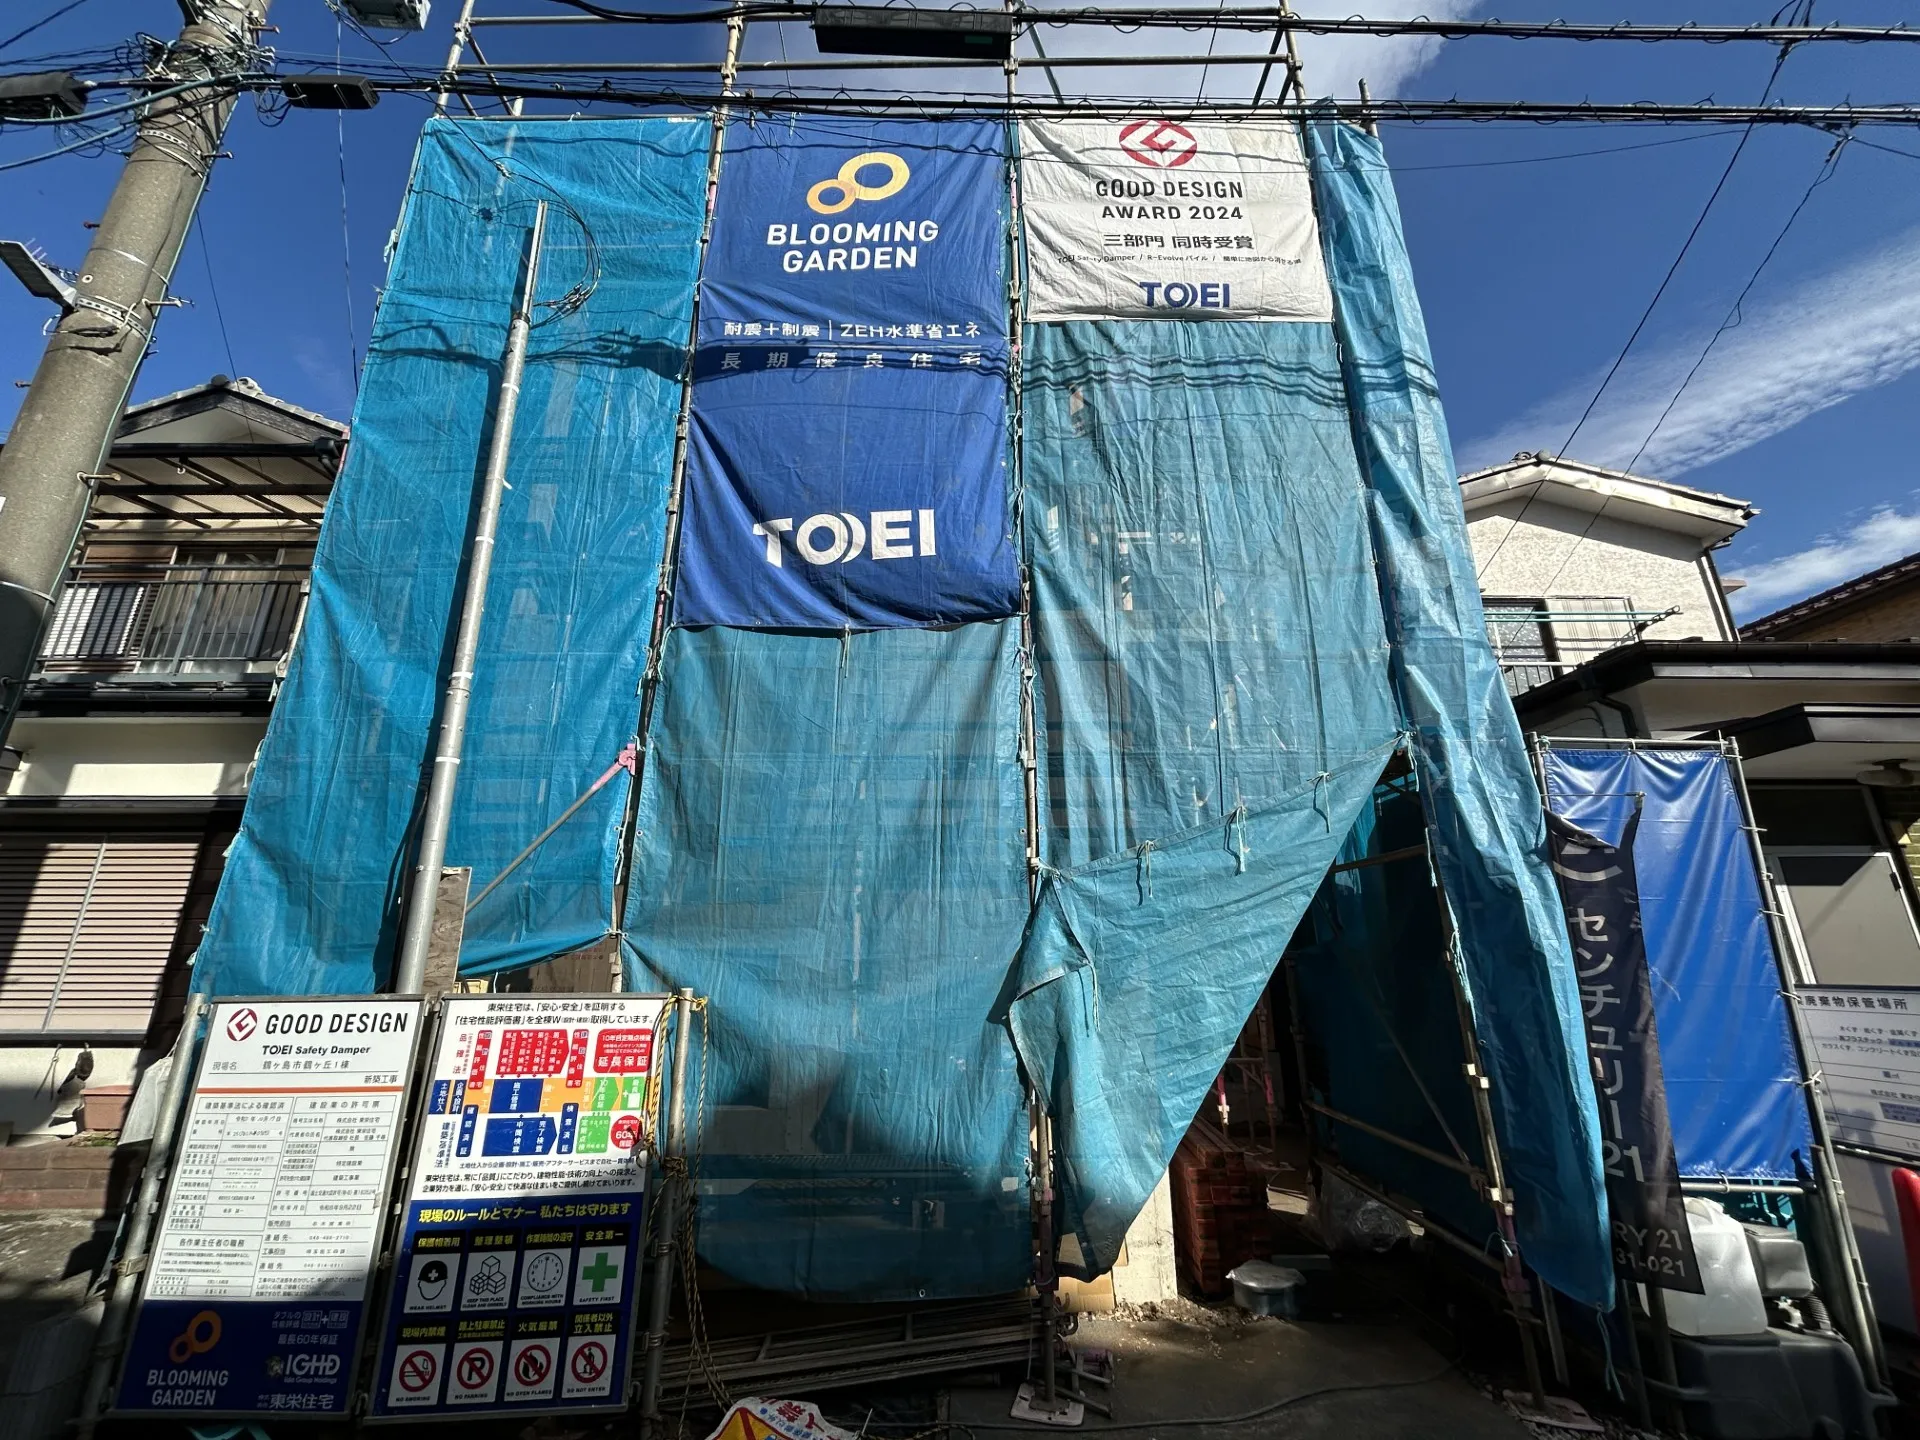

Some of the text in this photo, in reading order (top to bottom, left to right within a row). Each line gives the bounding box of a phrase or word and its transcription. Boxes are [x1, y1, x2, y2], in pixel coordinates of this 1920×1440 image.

[1095, 178, 1243, 198] GOOD DESIGN
[1102, 205, 1243, 220] AWARD 2024
[767, 220, 938, 245] BLOOMING
[1103, 233, 1254, 249] 三部門 同時受賞
[783, 246, 917, 273] GARDEN
[1139, 282, 1230, 308] TOEI
[840, 322, 981, 339] ZEH水準省エネ
[753, 508, 936, 568] TOEI
[265, 1012, 408, 1034] GOOD DESIGN
[262, 1045, 371, 1056] TOEI Safety Damper
[212, 1061, 238, 1071] 現場名
[598, 1056, 648, 1067] 延長保証
[364, 1075, 398, 1084] 新築工事
[436, 1082, 449, 1112] 土地仕入
[509, 1082, 521, 1111] 施工管理
[459, 1107, 475, 1155] 確認済証
[512, 1121, 524, 1153] 中間検査
[535, 1121, 547, 1153] 完了検査
[561, 1105, 574, 1152] 検査済証
[434, 1121, 451, 1168] 建築基準法
[419, 1202, 632, 1223] 現場のルールとマナー 私たちは守ります
[585, 1230, 624, 1241] 安全第一
[1656, 1228, 1683, 1251] 21
[458, 1321, 505, 1331] 路上駐車禁止
[518, 1321, 558, 1332] 火気厳禁
[574, 1313, 614, 1323] 関係者以外
[402, 1326, 446, 1338] 現場内禁煙
[573, 1323, 613, 1334] 立入禁止
[278, 1334, 339, 1345] 最長60年保証
[285, 1353, 341, 1376] IGHD
[146, 1369, 229, 1387] BLOOMING
[151, 1389, 216, 1406] GARDEN
[269, 1393, 334, 1410] 東栄住宅
